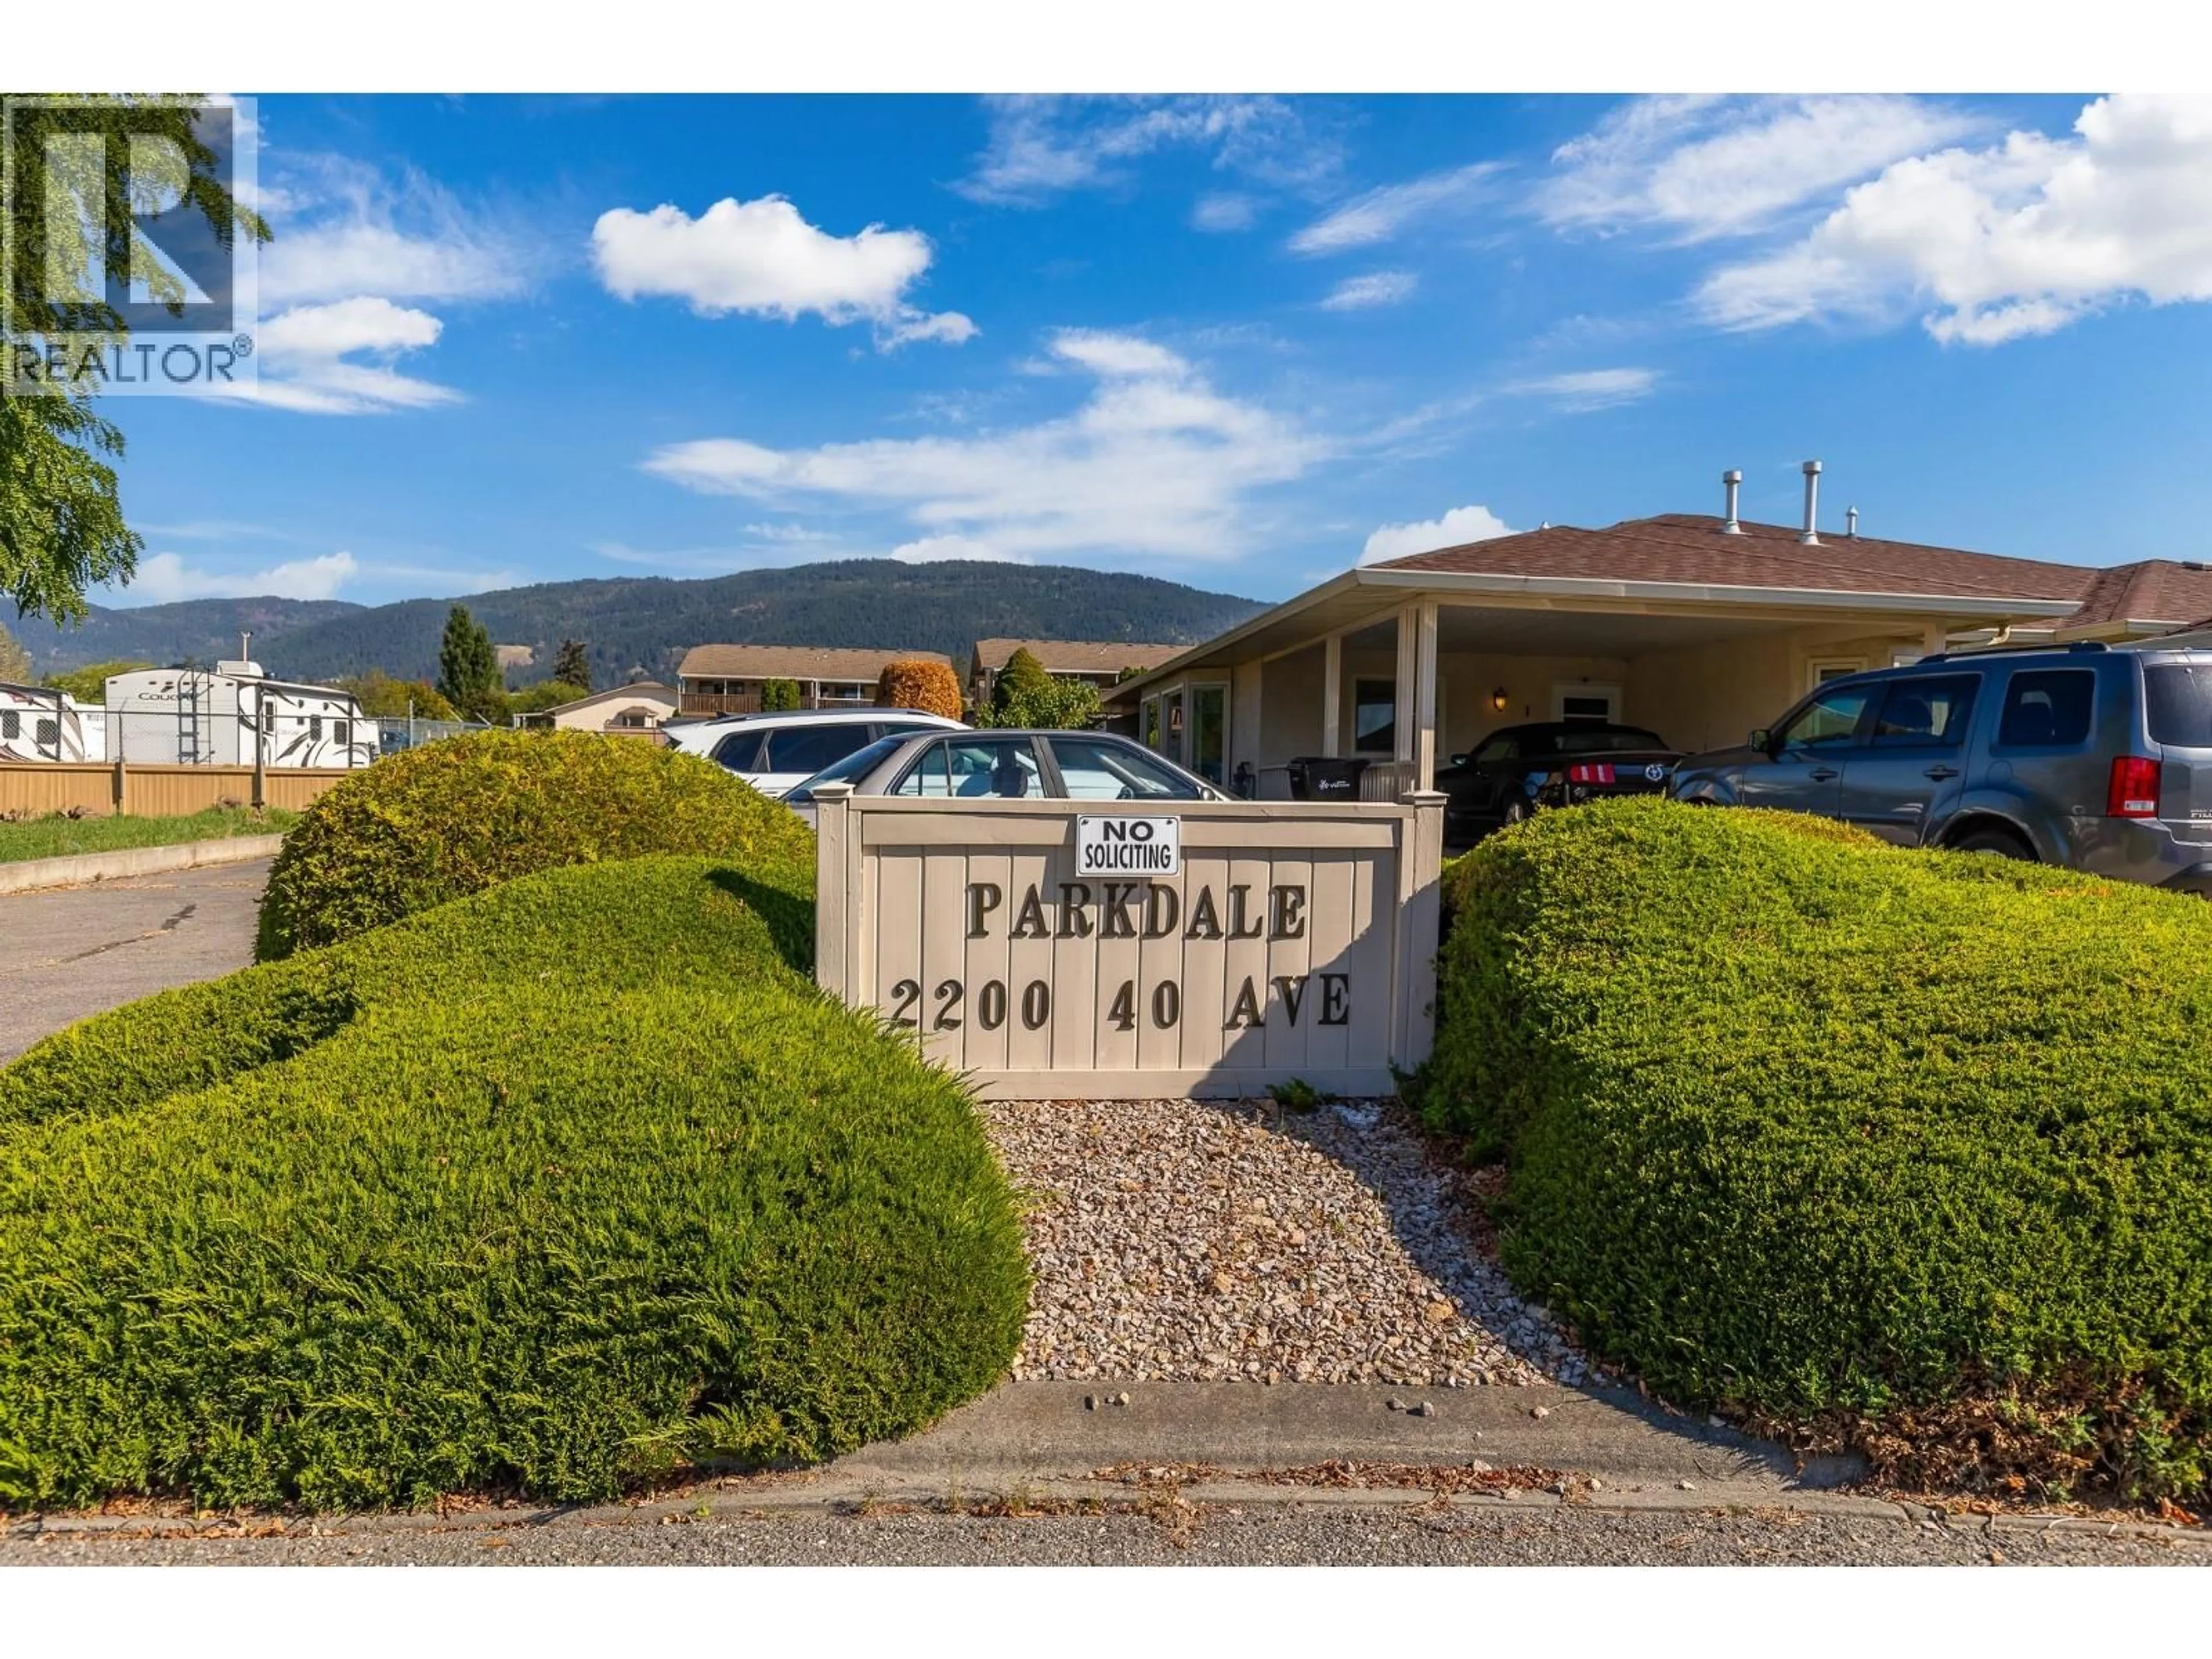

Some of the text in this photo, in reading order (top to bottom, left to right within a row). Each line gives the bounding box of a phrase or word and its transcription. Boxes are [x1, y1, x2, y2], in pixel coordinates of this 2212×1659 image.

[1103, 821, 1154, 842] NO
[1085, 843, 1171, 869] SOLICITING
[965, 882, 1306, 941] PARKDALE
[889, 973, 1349, 1031] 2200 40 AVE
